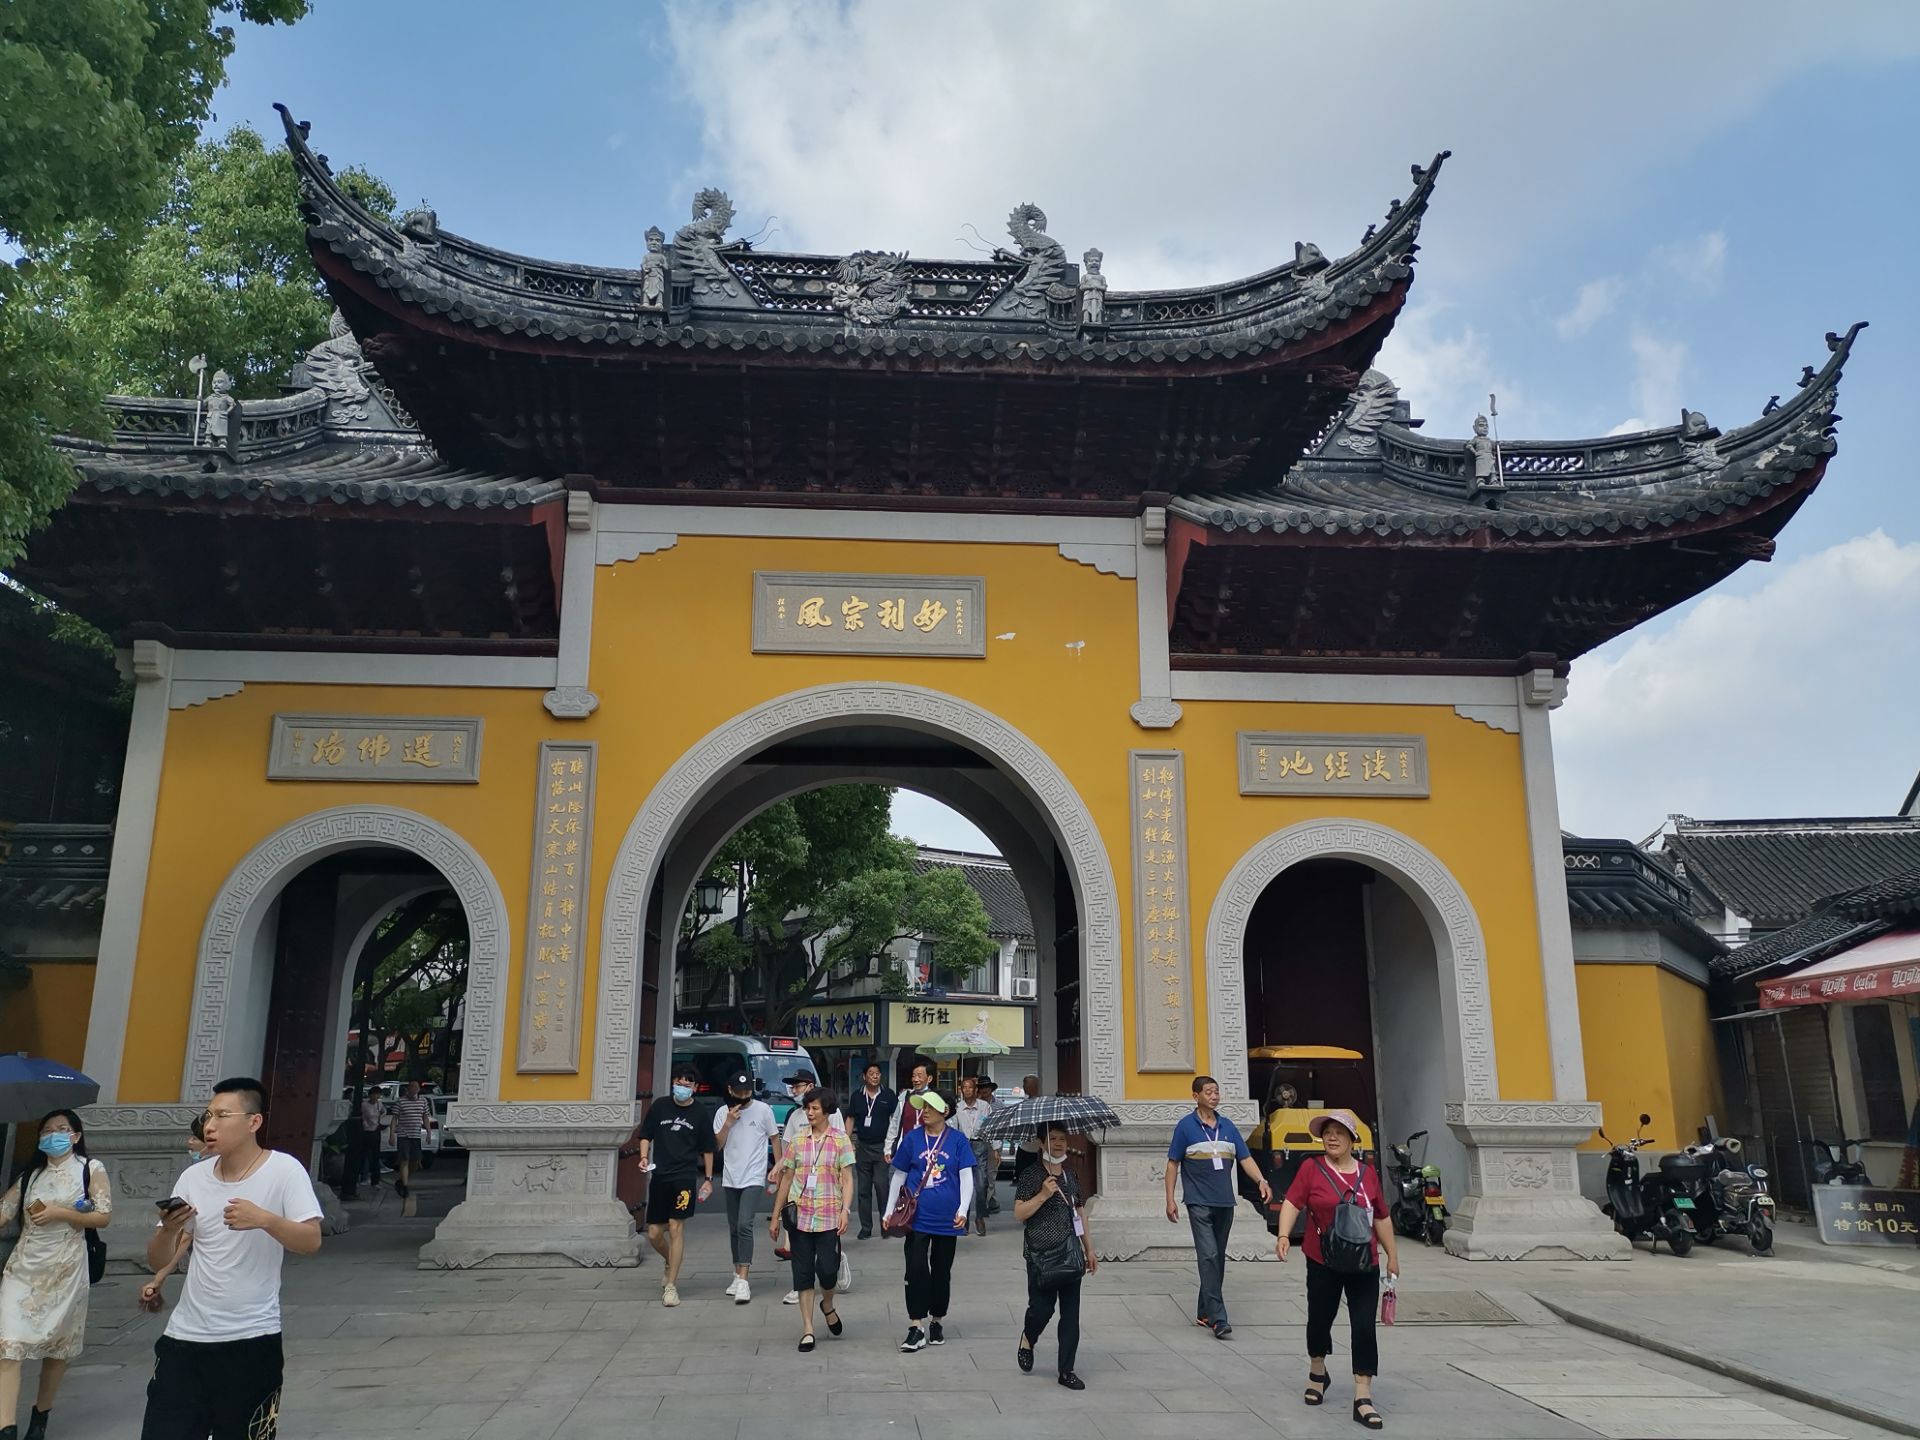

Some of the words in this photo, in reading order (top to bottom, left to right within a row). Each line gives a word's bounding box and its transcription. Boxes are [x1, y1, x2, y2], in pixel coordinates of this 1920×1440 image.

[1820, 976, 1849, 997] 可口可乐
[905, 1005, 951, 1025] 旅行社
